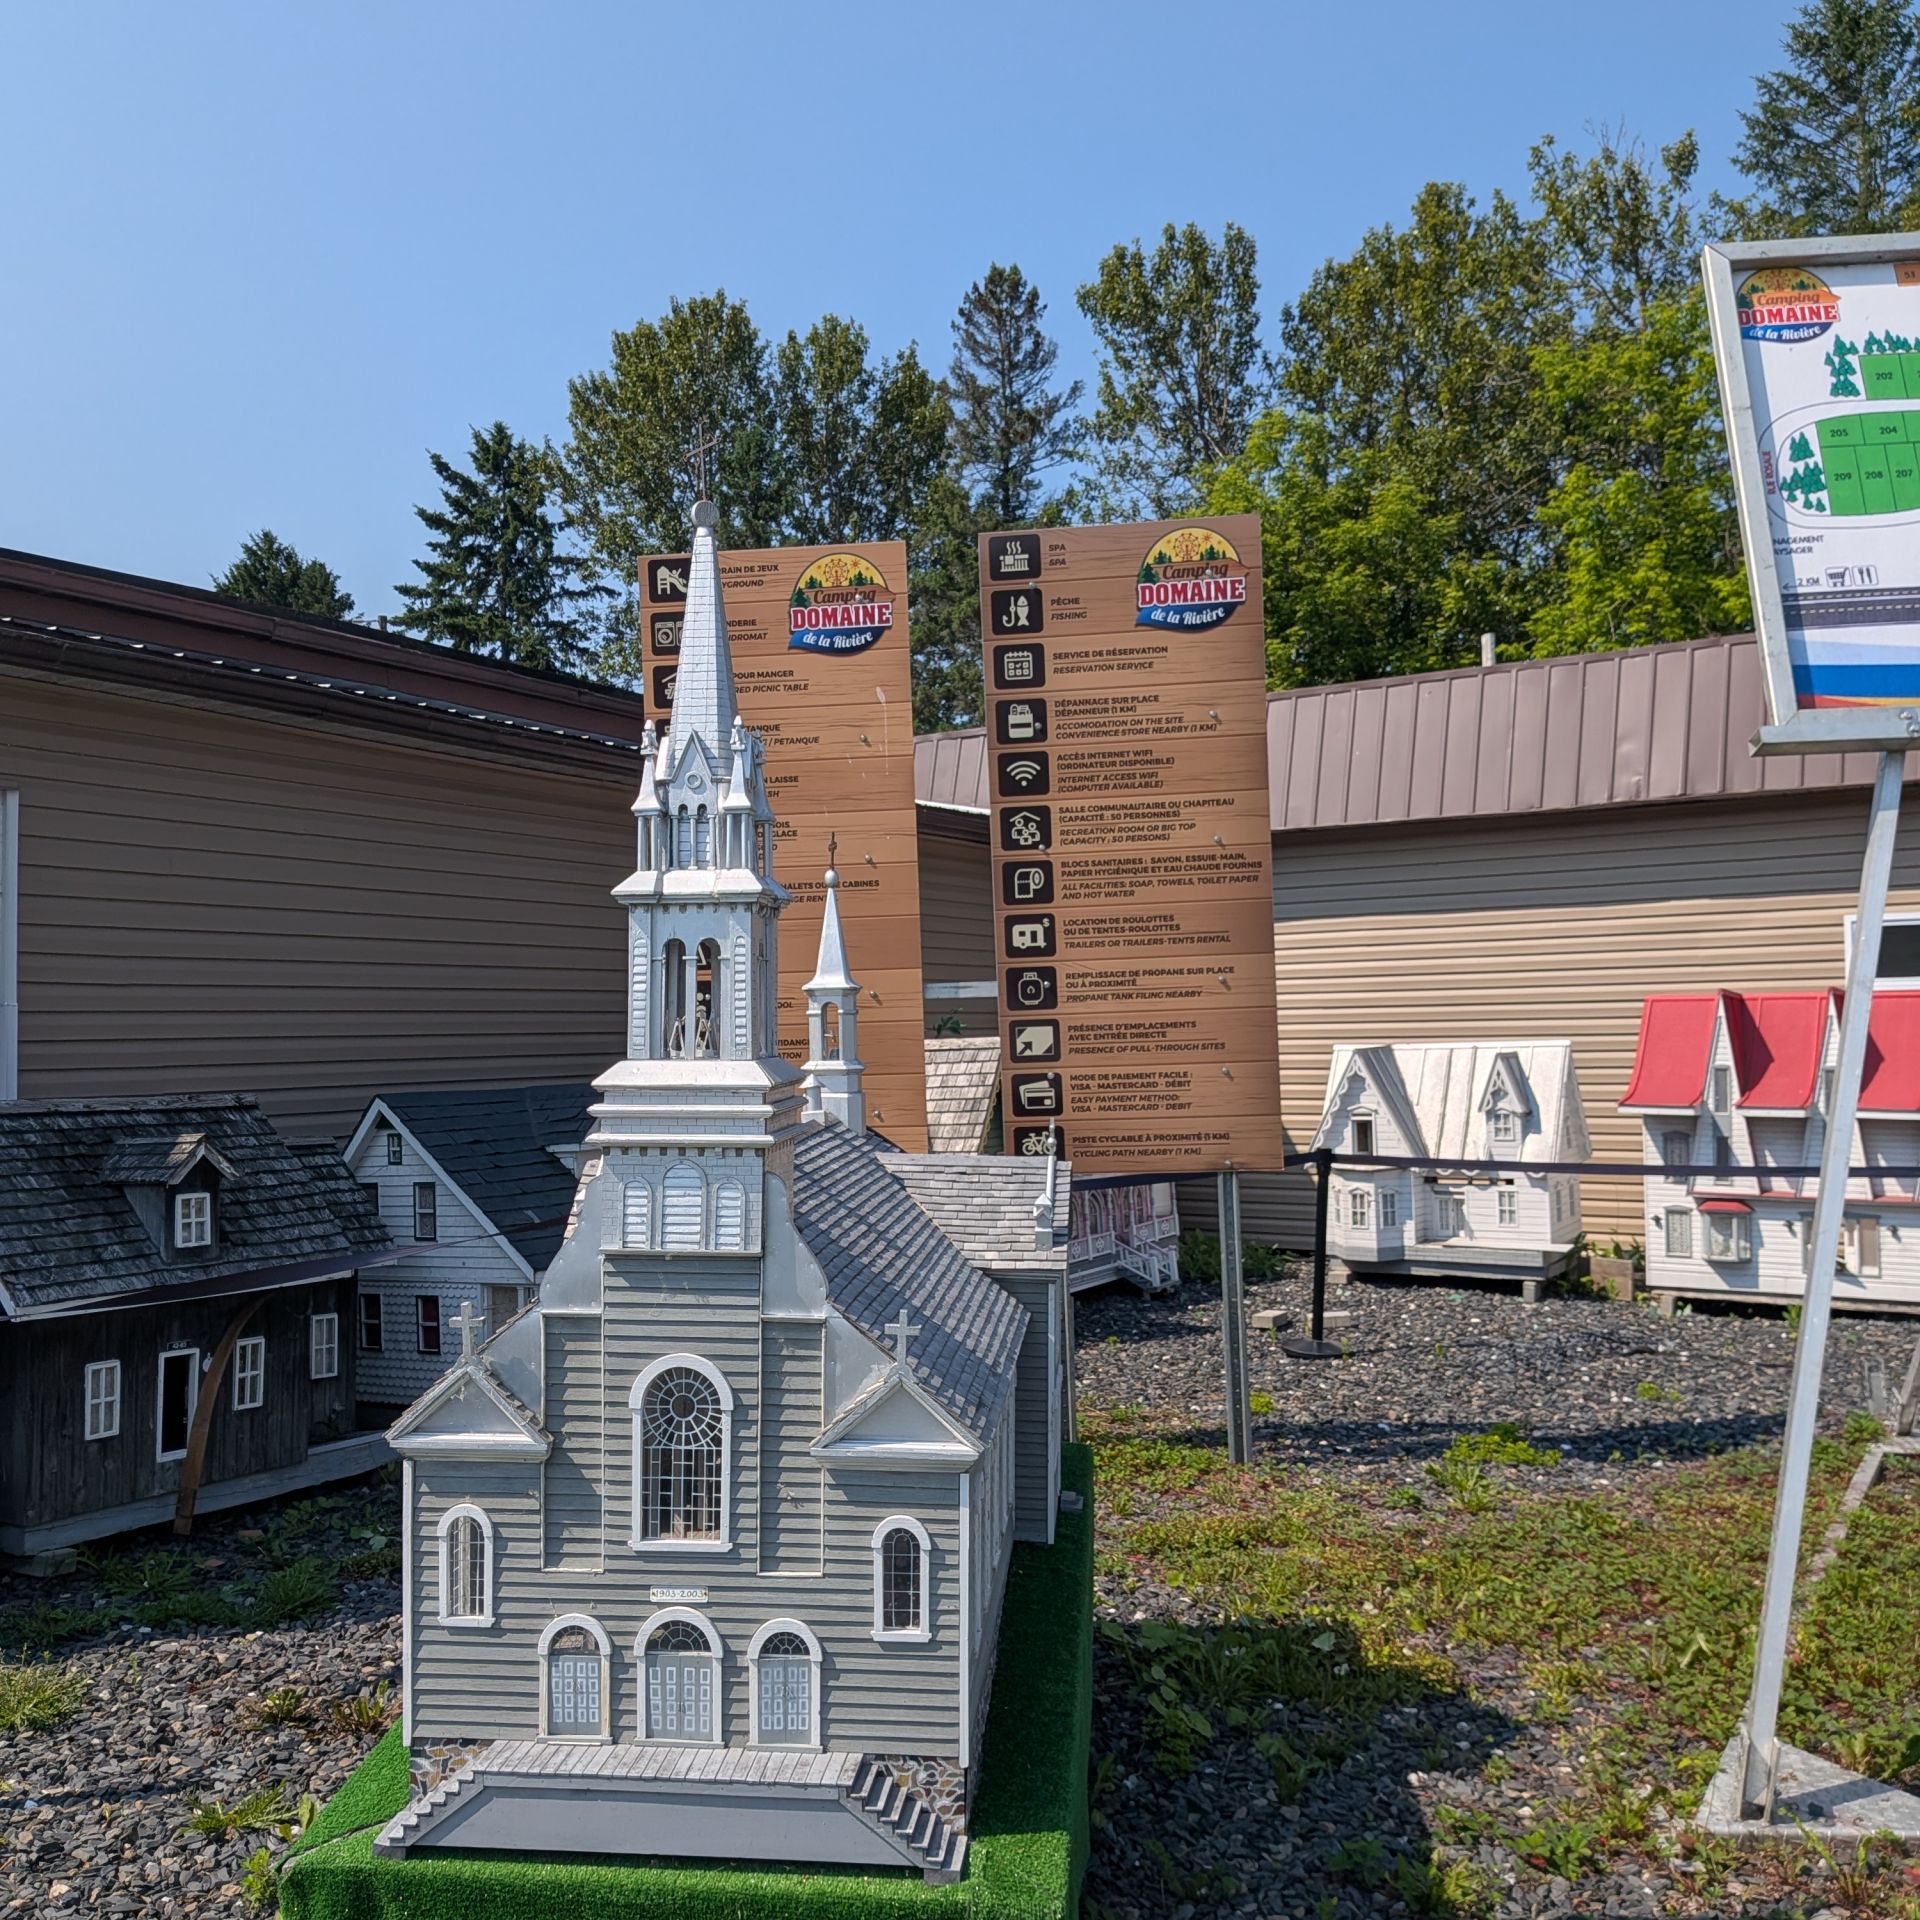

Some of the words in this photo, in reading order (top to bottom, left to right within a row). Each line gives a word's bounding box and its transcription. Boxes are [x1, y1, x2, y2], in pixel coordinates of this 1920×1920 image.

[1757, 293, 1820, 306] Camping
[1738, 304, 1838, 325] DOMAINE
[1749, 328, 1764, 338] de
[1765, 329, 1778, 339] la
[1780, 326, 1821, 340] Rivière
[1875, 372, 1893, 380] 202
[1830, 429, 1848, 438] 205
[1880, 426, 1898, 434] 204
[1834, 472, 1852, 481] 209
[1895, 469, 1913, 478] 207
[1048, 558, 1066, 566] SPA
[744, 565, 755, 573] DE
[757, 564, 779, 572] JEUX
[1163, 563, 1229, 580] Camping
[814, 588, 876, 604] Camping
[1140, 579, 1244, 606] DOMAINE
[1050, 596, 1079, 606] PÊCHE
[792, 604, 891, 630] DOMAINE
[1051, 611, 1087, 620] FISHING
[1151, 609, 1166, 621] de
[1167, 611, 1180, 624] la
[1183, 608, 1225, 624] Rivière
[803, 632, 817, 644] de
[818, 634, 830, 646] la
[833, 632, 873, 648] Rivière
[1052, 651, 1089, 659] SERVICE
[1105, 644, 1167, 656] RÉSERVATION
[1053, 663, 1115, 674] RESERVATION
[1115, 661, 1153, 670] SERVICE
[757, 670, 794, 678] MANGER
[752, 684, 781, 693] PICNIC
[783, 683, 810, 692] TABLE
[1054, 696, 1109, 707] DÉPANNAGE
[1130, 695, 1159, 703] PLACE
[1055, 705, 1109, 716] DÉPANNEUR
[1055, 719, 1128, 730] ACCOMODATION
[1129, 718, 1143, 726] ON
[1144, 717, 1163, 725] THE
[1163, 716, 1183, 724] SITE
[1055, 728, 1120, 738] CONVENIENCE
[1120, 727, 1150, 735] STORE
[1151, 725, 1188, 734] NEARBY
[774, 736, 820, 746] PETANQUE
[1057, 751, 1085, 761] ACCÈS
[1087, 751, 1130, 759] INTERNET
[769, 776, 799, 784] LAISSE
[1057, 774, 1100, 783] INTERNET
[1102, 772, 1137, 781] ACCESS
[1138, 771, 1158, 780] WIFI
[1059, 805, 1085, 813] SALLE
[1087, 801, 1166, 812] COMMUNAUTAIRE
[1182, 798, 1234, 808] CHAPITEAU
[1059, 826, 1116, 836] RECREATION
[1116, 824, 1145, 833] ROOM
[1145, 824, 1159, 832] OR
[1160, 823, 1176, 831] BIG
[1177, 822, 1195, 831] TOP
[1060, 859, 1089, 867] BLOCS
[1091, 857, 1141, 866] SANITAIRES
[1094, 865, 1149, 876] HYGIÉNIQUE
[1163, 865, 1181, 873] EAU
[1183, 864, 1221, 872] CHAUDE
[1222, 862, 1262, 870] FOURNIS
[842, 880, 880, 888] CABINES
[1061, 881, 1077, 890] ALL
[1196, 876, 1227, 884] TOILET
[1227, 875, 1258, 883] PAPER
[1061, 891, 1082, 899] AND
[1082, 890, 1101, 899] HOT
[1103, 889, 1134, 898] WATER
[1063, 917, 1107, 926] LOCATION
[1108, 916, 1120, 924] DE
[1122, 915, 1174, 924] ROULOTTES
[1063, 927, 1076, 935] OU
[1092, 923, 1180, 934] TENTES-ROULOTTES
[1064, 939, 1106, 948] TRAILERS
[1121, 936, 1195, 946] TRAILERS-TENTS
[1195, 935, 1230, 943] RENTAL
[1065, 970, 1126, 979] REMPLISSAGE
[1128, 969, 1140, 977] DE
[1142, 968, 1184, 977] PROPANE
[1186, 967, 1204, 975] SUR
[1205, 966, 1234, 975] PLACE
[1080, 979, 1086, 988] À
[1088, 977, 1136, 987] PROXIMITÉ
[1066, 993, 1109, 1001] PROPANE
[1110, 992, 1134, 1000] TANK
[1134, 991, 1164, 999] FILING
[1164, 990, 1202, 998] NEARBY
[1067, 1022, 1113, 1032] PRÉSENCE
[1093, 1031, 1127, 1040] ENTRÉE
[1068, 1045, 1115, 1054] PRESENCE
[1129, 1043, 1199, 1052] PULL-THROUGH
[1200, 1042, 1225, 1050] SITES
[1069, 1073, 1095, 1081] MODE
[1111, 1072, 1155, 1080] PAIEMENT
[1158, 1071, 1188, 1079] FACILE
[1164, 1079, 1190, 1088] DÉBIT
[1094, 1095, 1137, 1103] PAYMENT
[1071, 1104, 1091, 1112] VISA
[1097, 1103, 1159, 1111] MASTERCARD
[1164, 1102, 1191, 1110] DEBIT
[1145, 1133, 1151, 1141] À
[1153, 1132, 1202, 1141] PROXIMITÉ
[1111, 1148, 1135, 1156] PATH
